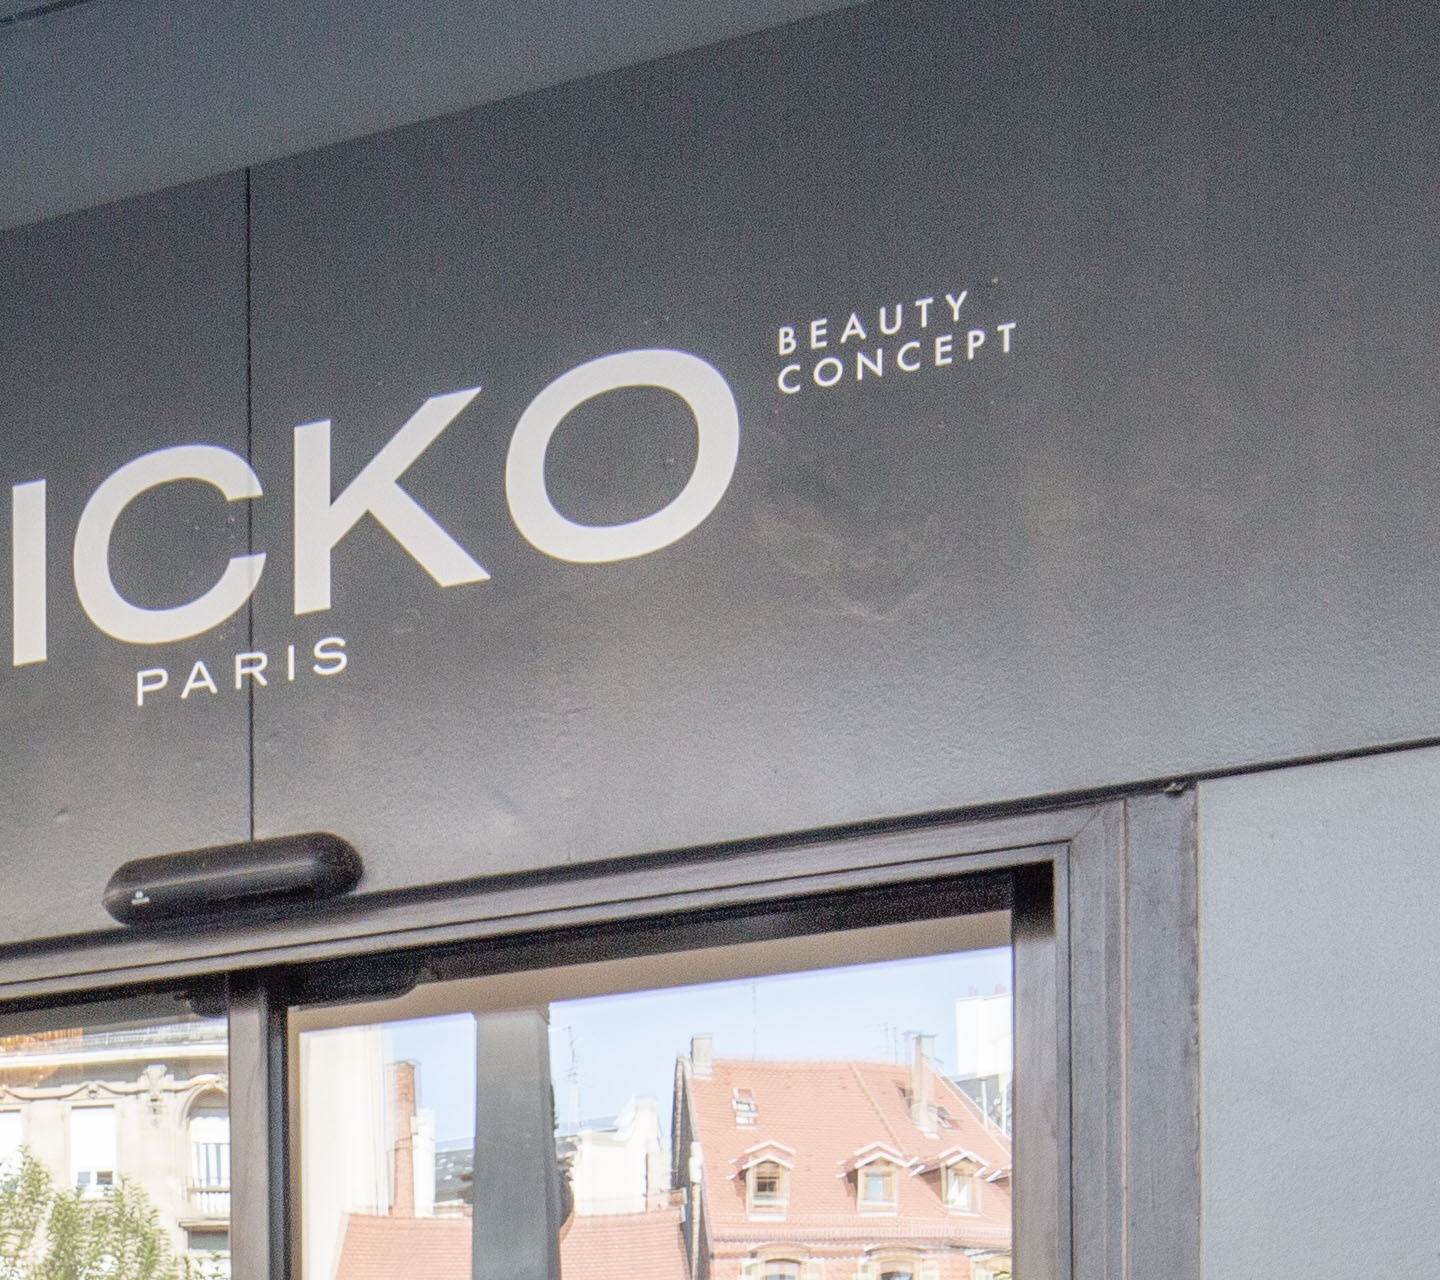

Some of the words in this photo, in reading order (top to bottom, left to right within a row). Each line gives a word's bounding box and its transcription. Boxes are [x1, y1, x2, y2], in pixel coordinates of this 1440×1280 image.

[777, 290, 969, 355] BEAUTY
[777, 322, 1020, 395] CONCEPT
[137, 634, 349, 707] PARIS
